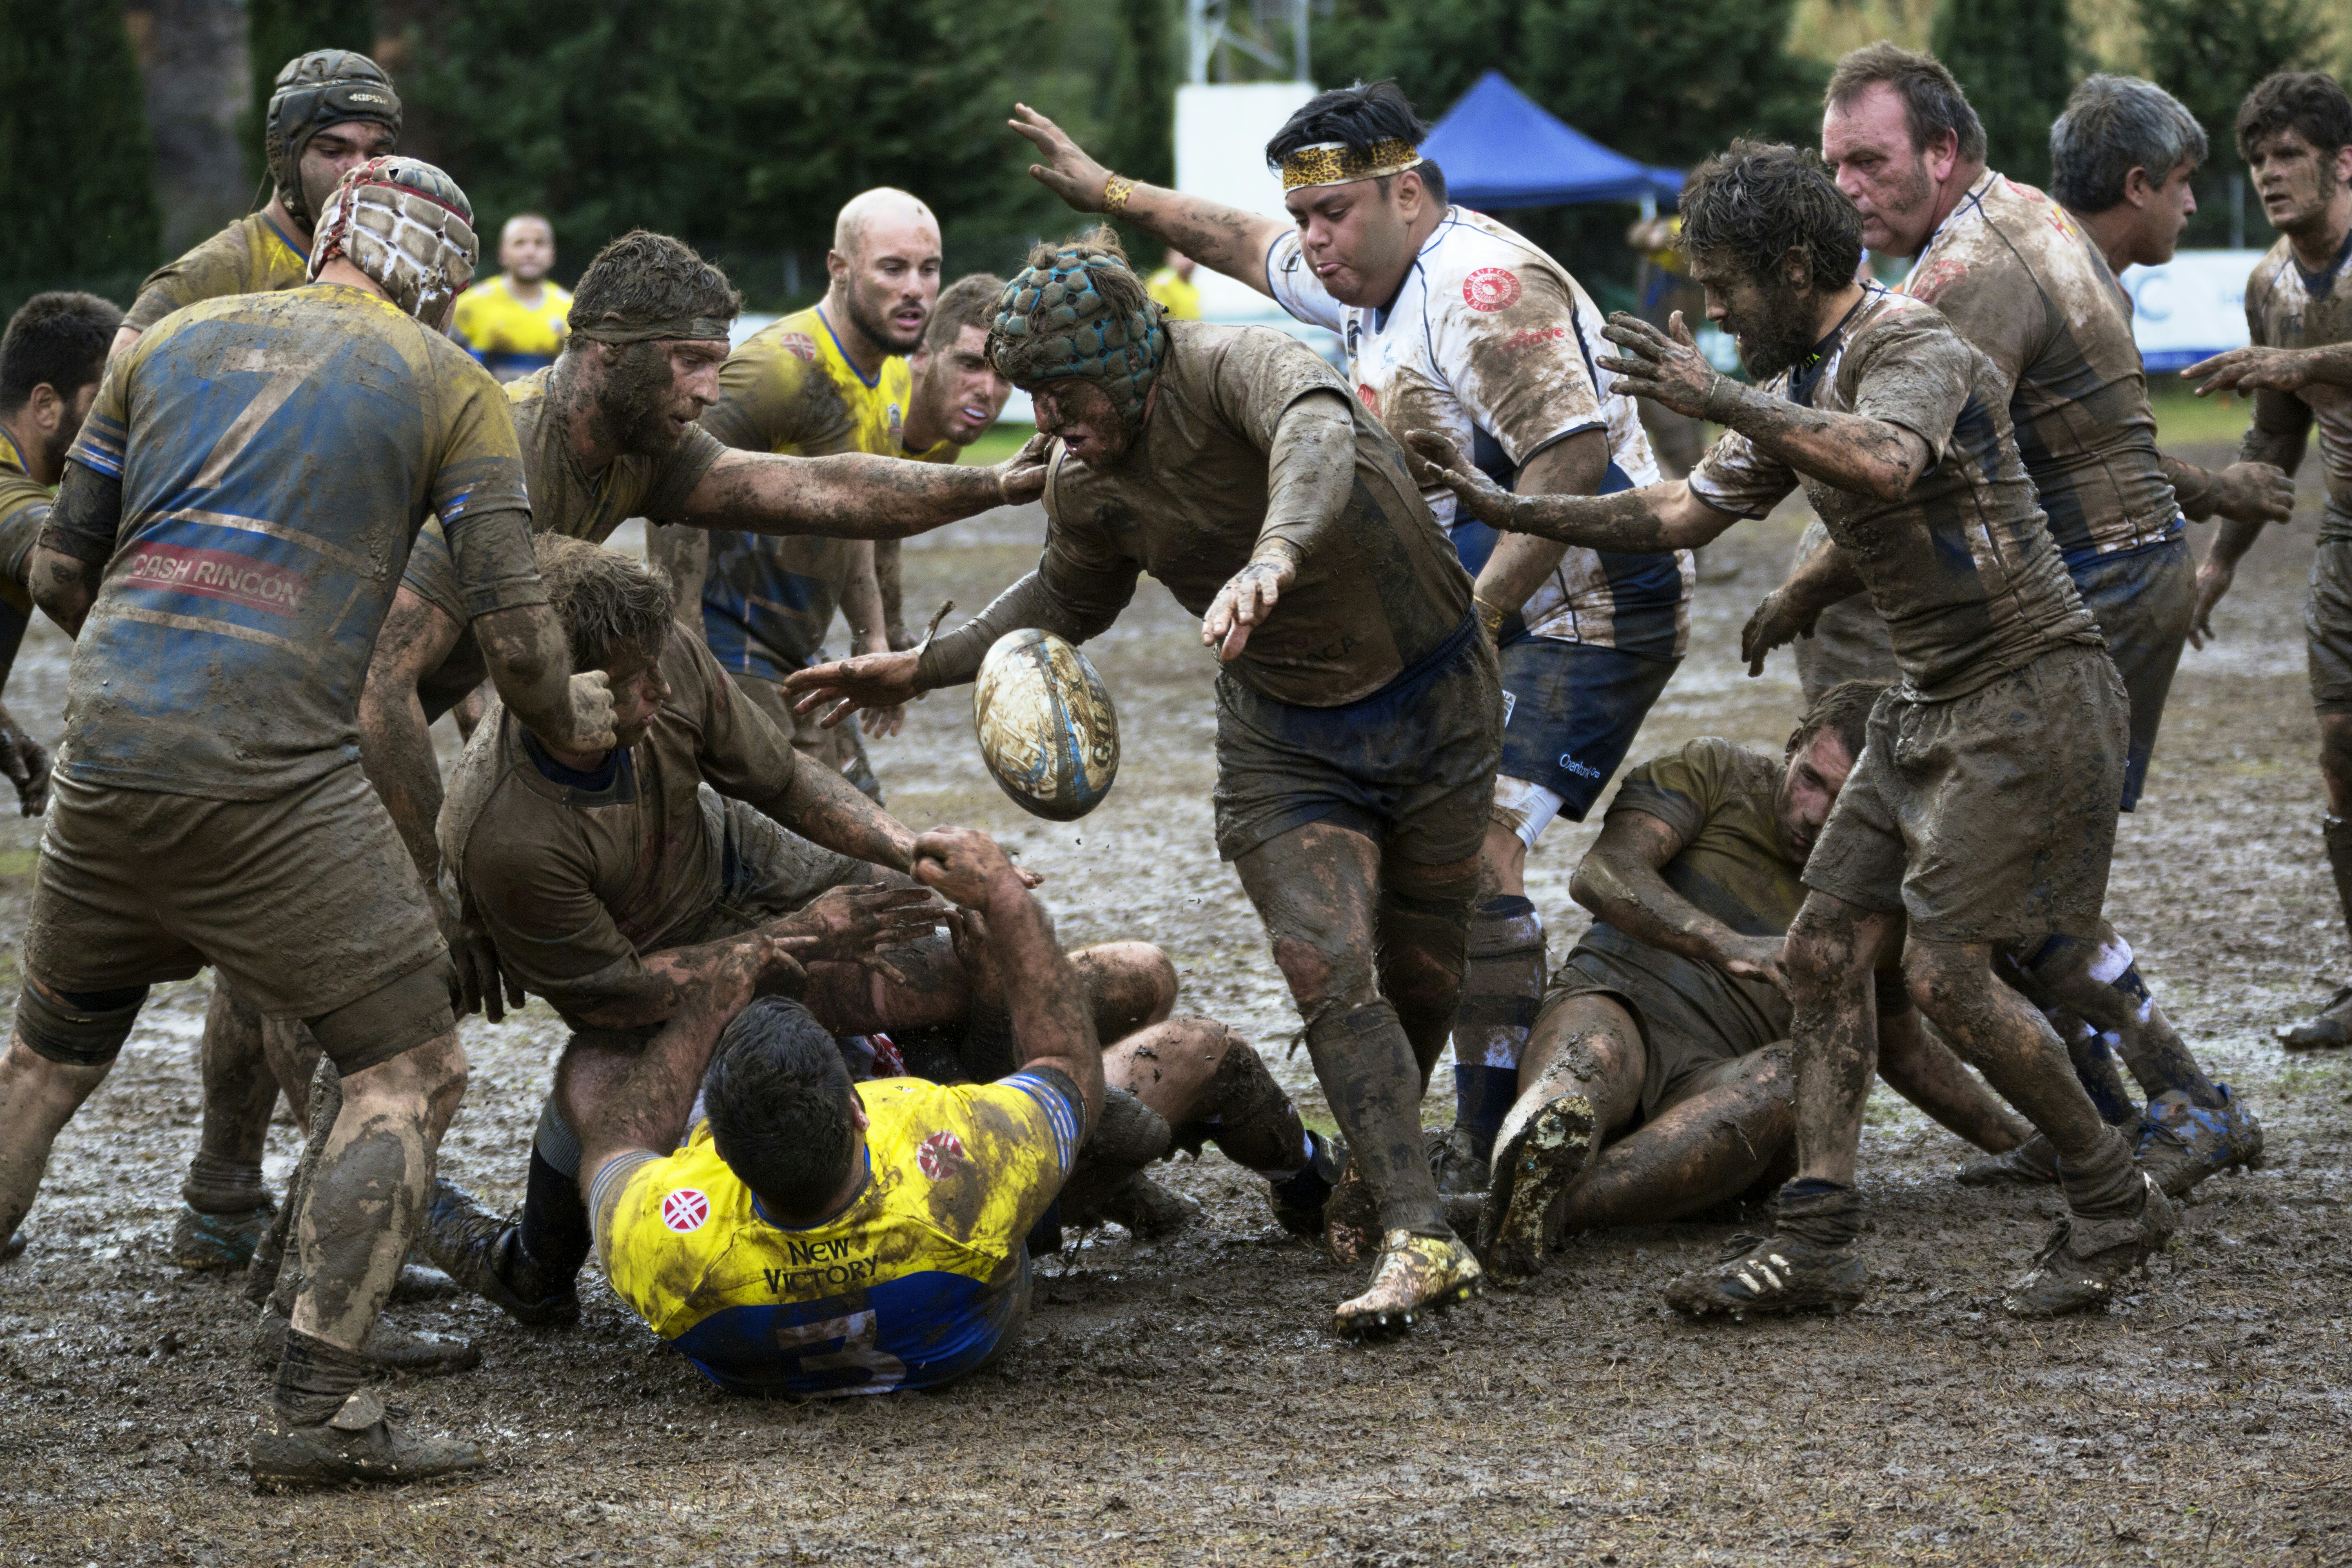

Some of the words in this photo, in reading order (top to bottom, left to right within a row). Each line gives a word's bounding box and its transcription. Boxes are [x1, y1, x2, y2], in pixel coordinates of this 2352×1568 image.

[1464, 268, 1506, 290] GRUPO
[186, 346, 329, 490] 7
[131, 554, 194, 580] CASH
[193, 561, 304, 607] RINCÓN
[763, 1254, 879, 1295] VICTORY
[776, 1309, 908, 1396] 3
